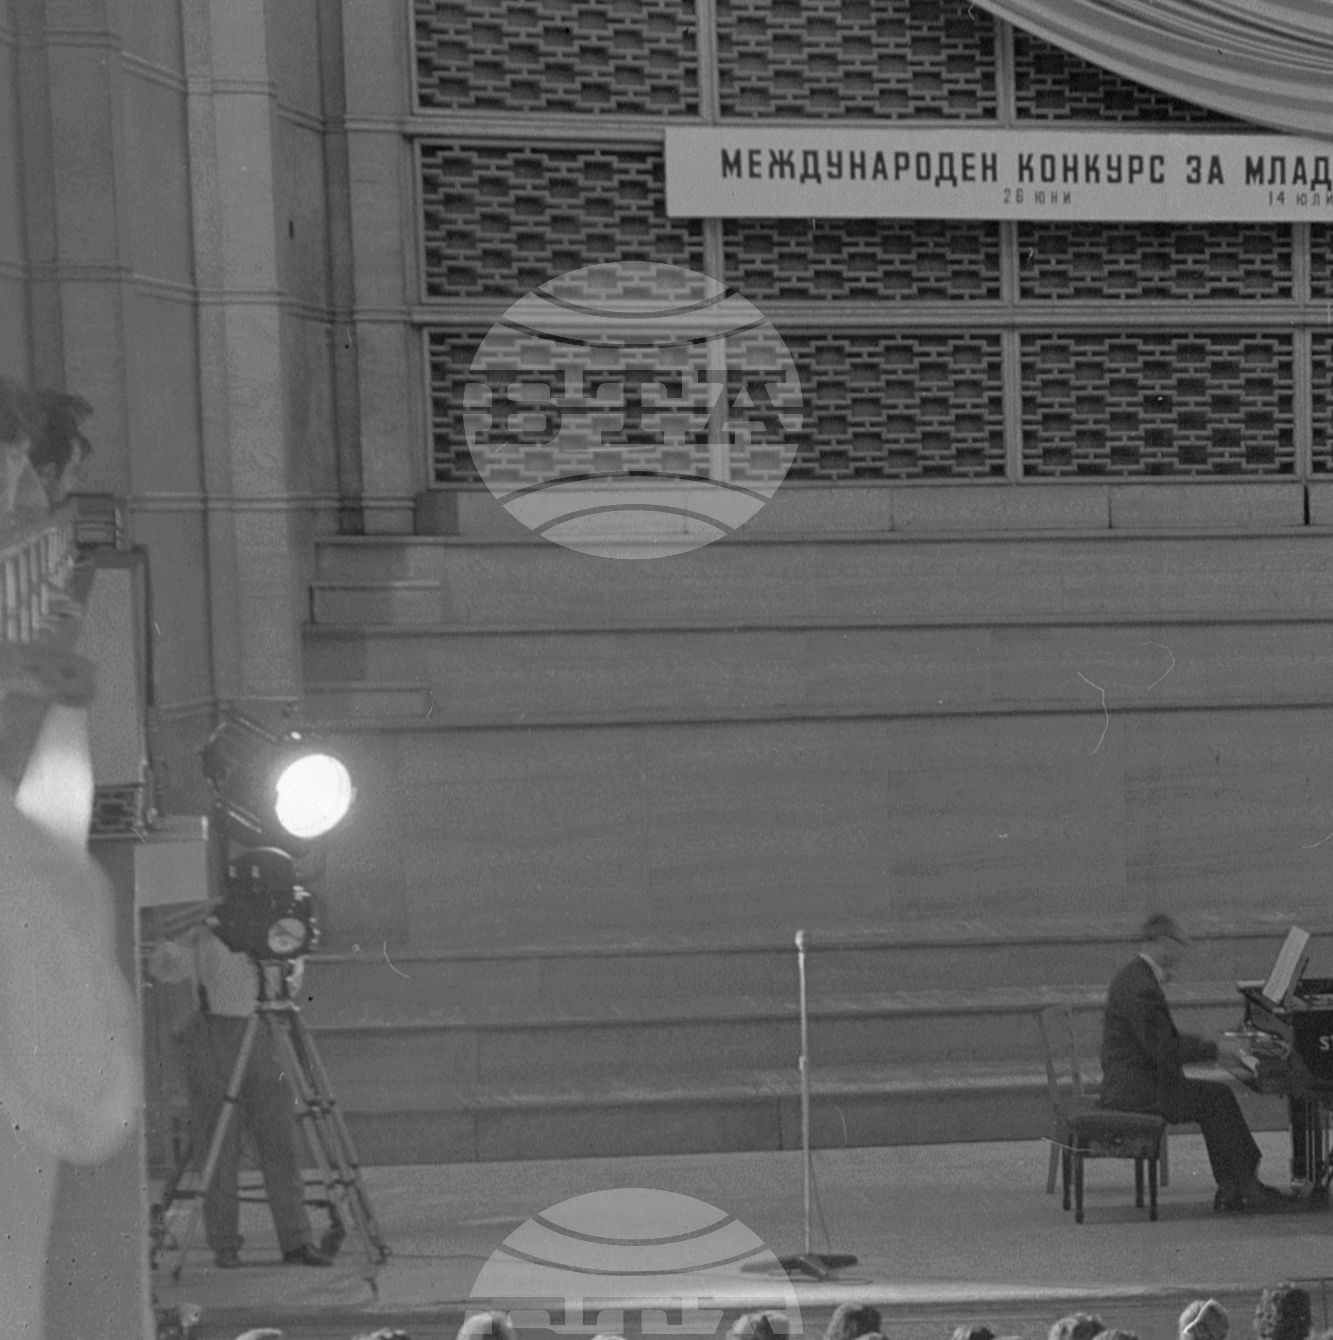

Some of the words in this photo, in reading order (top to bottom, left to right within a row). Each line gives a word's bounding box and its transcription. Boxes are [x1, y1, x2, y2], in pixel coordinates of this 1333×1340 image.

[721, 148, 998, 187] МЕЖДУНАРОДЕН
[1018, 153, 1165, 184] КОНКУРС
[1186, 155, 1224, 184] ЗА
